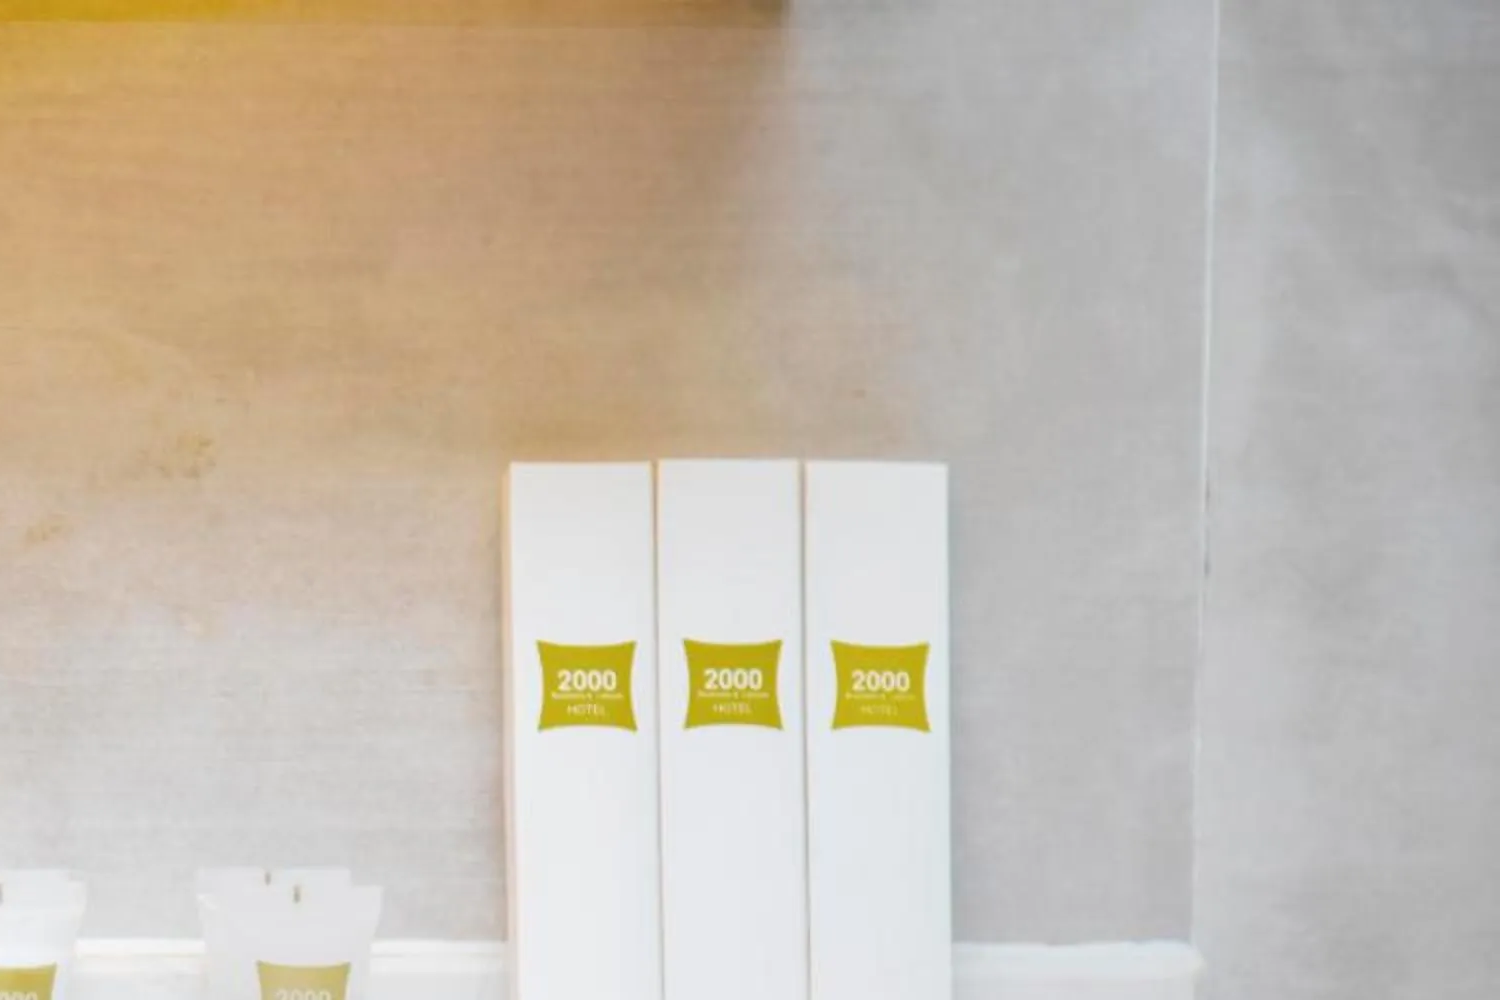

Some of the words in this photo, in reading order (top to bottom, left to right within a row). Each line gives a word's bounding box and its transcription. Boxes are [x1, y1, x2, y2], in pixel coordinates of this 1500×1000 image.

[557, 669, 617, 691] 2000
[704, 668, 763, 690] 2000
[851, 669, 910, 692] 2000
